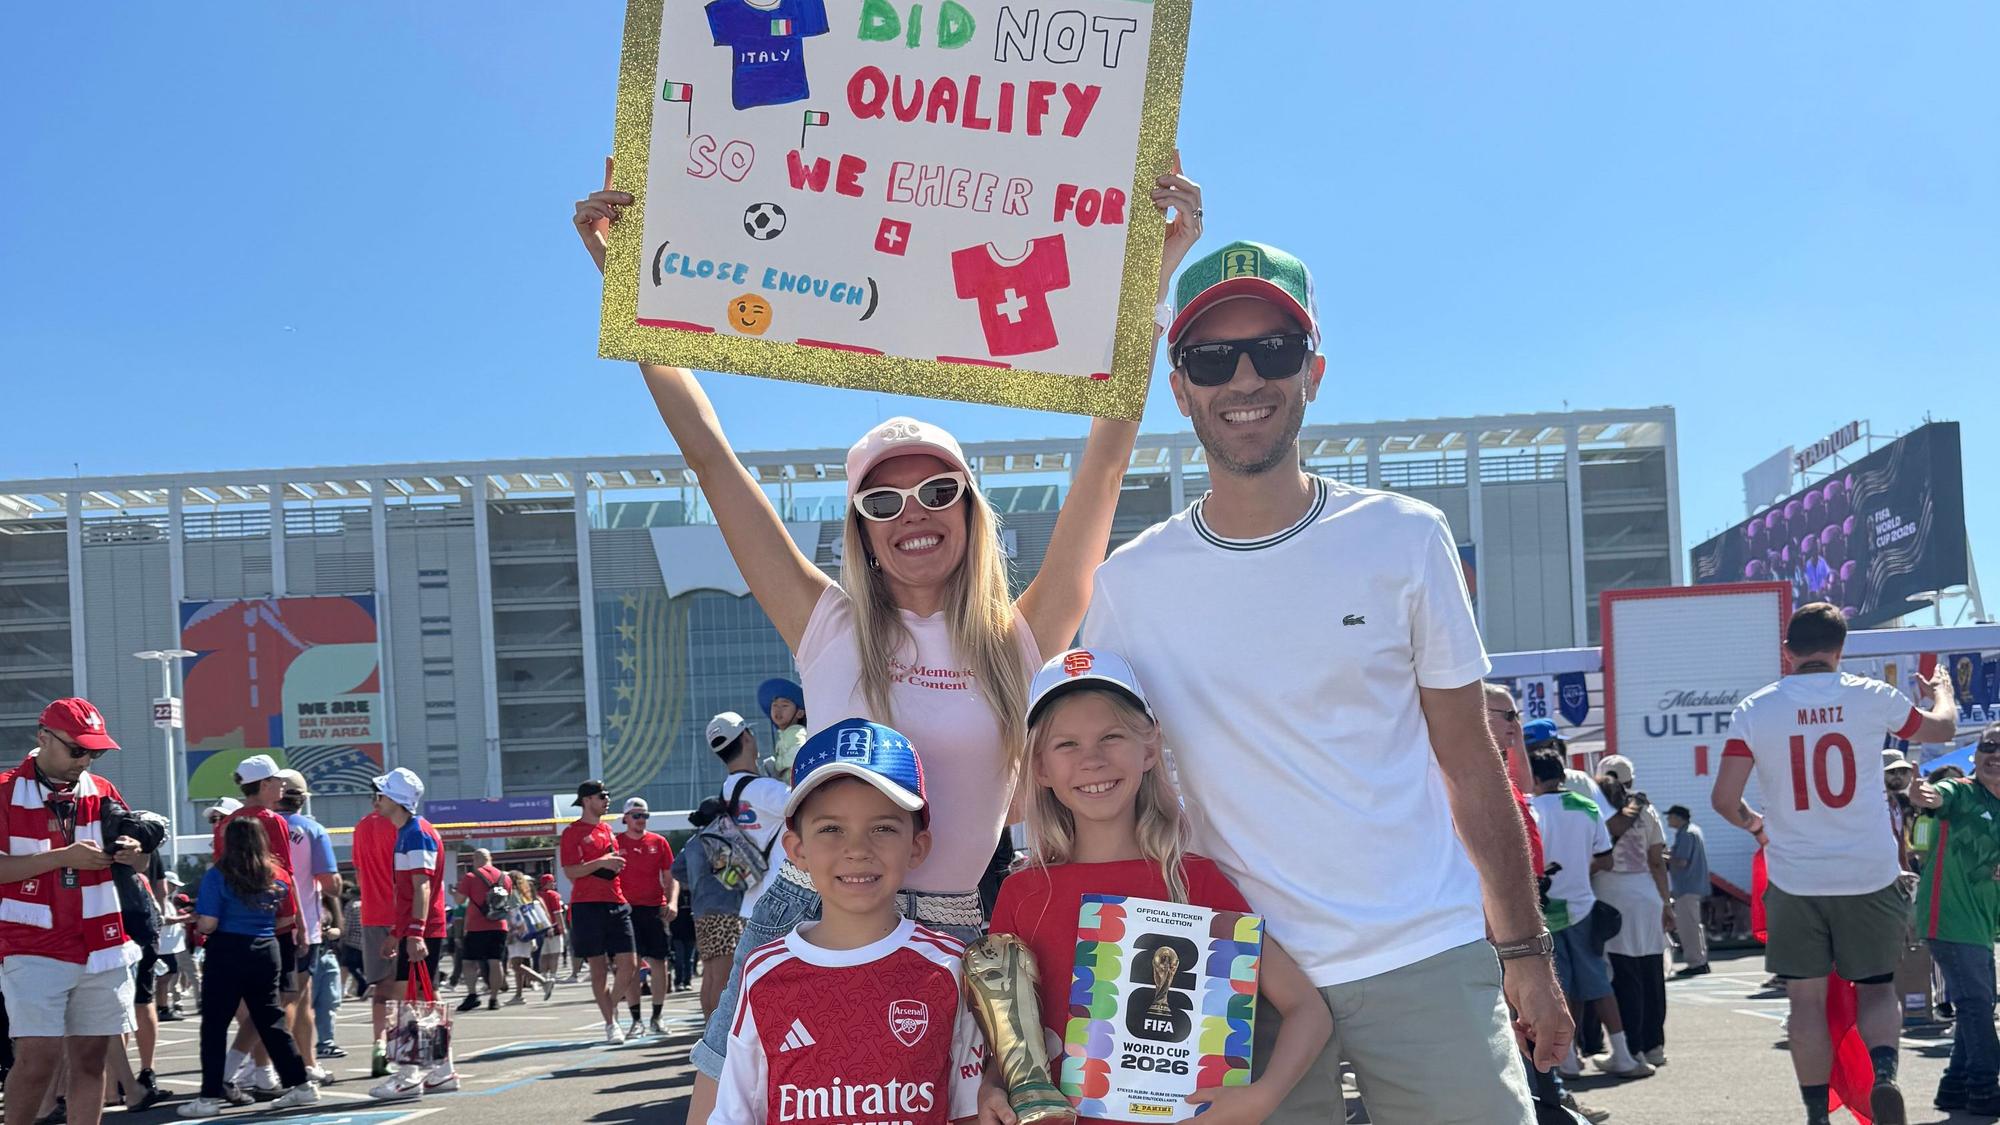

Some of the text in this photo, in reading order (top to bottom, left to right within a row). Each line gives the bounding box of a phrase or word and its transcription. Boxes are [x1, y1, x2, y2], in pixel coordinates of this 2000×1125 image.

[857, 0, 1137, 68] DID NOT
[741, 48, 790, 63] ITALY
[847, 65, 1102, 138] QUALIFY
[687, 134, 1127, 227] SO WE CHEER FOR
[1795, 420, 1859, 472] STADIUM
[1875, 507, 1891, 522] FIFA
[1875, 516, 1901, 535] WORLD
[1876, 521, 1916, 547] CUP 2026
[912, 664, 976, 679] Memorie
[908, 676, 968, 690] Content
[298, 700, 370, 715] WE ARE
[1658, 688, 1740, 710] Michelob
[155, 706, 170, 717] 22
[1528, 701, 1547, 718] 26
[1797, 705, 1844, 726] MARTZ
[299, 726, 371, 739] BAY AREA
[1644, 711, 1733, 738] ULTR
[1789, 732, 1857, 812] 10
[1136, 907, 1203, 921] OFFICIAL STICKER
[1146, 916, 1193, 928] COLLECTION
[894, 1006, 923, 1016] Arsenal
[1144, 1018, 1174, 1034] FIFA
[1123, 1041, 1190, 1058] WORLD CUP
[1120, 1054, 1189, 1075] 2026
[778, 1076, 935, 1122] Emirates
